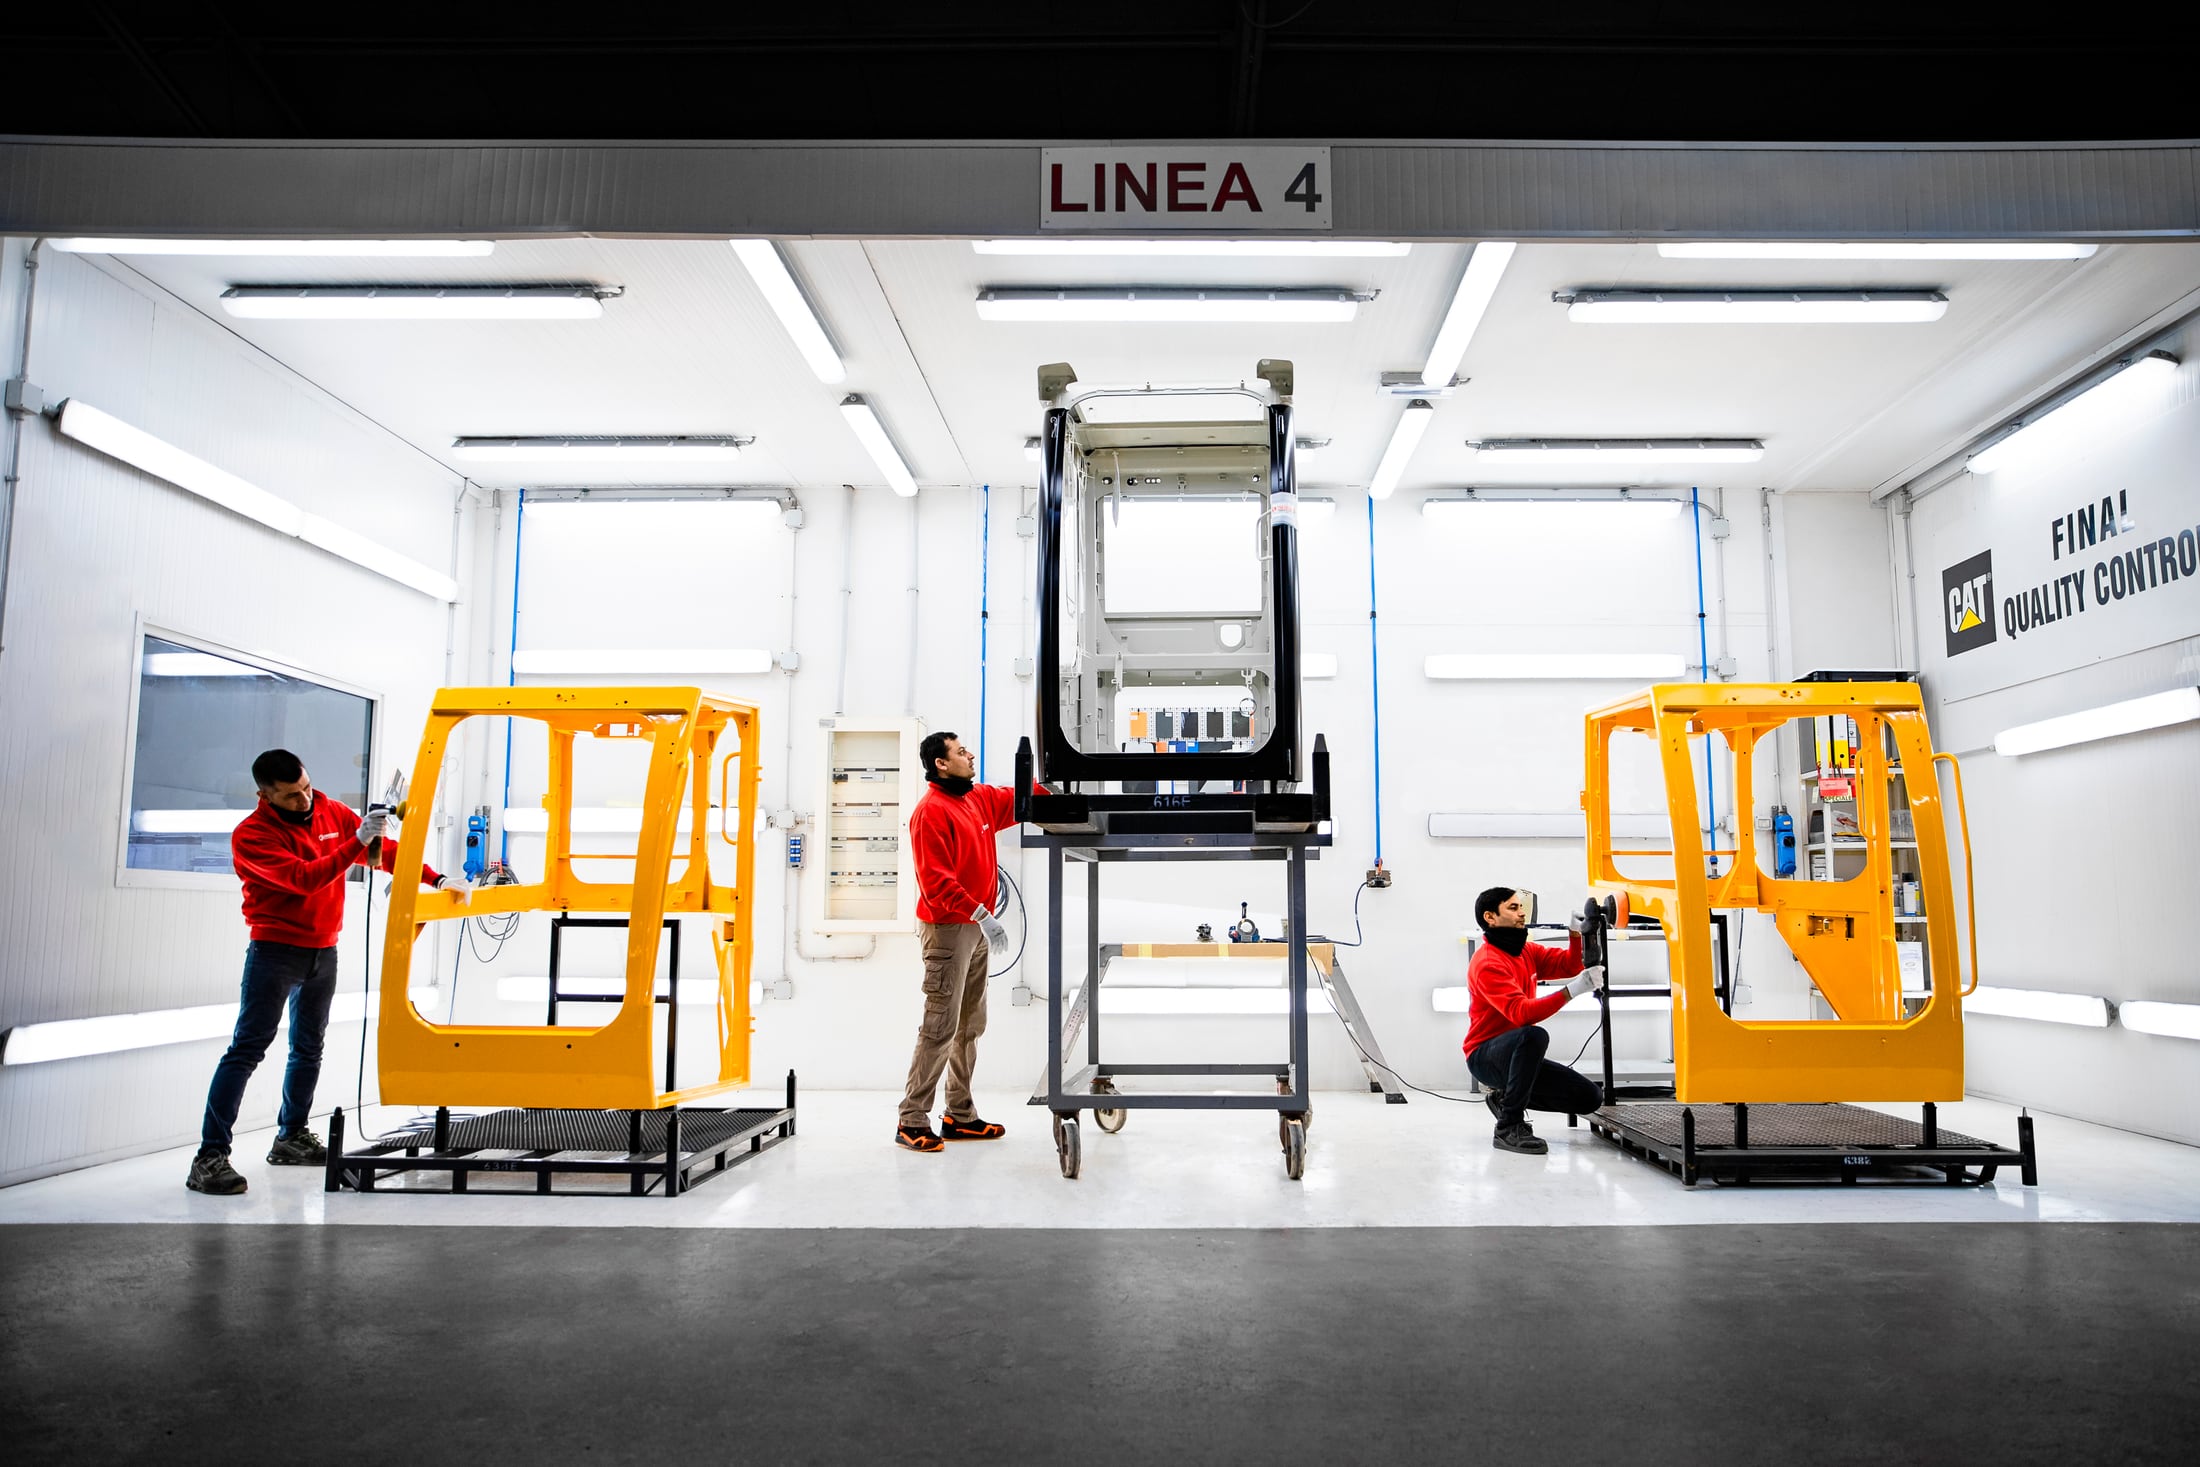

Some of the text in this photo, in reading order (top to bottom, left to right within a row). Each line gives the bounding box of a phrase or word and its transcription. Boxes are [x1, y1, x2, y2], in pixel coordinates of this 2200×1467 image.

[1051, 162, 1322, 213] LINEA 4
[2051, 488, 2135, 561] FINAL
[1948, 573, 1988, 634] CAT
[2003, 569, 2086, 640] QUALITY
